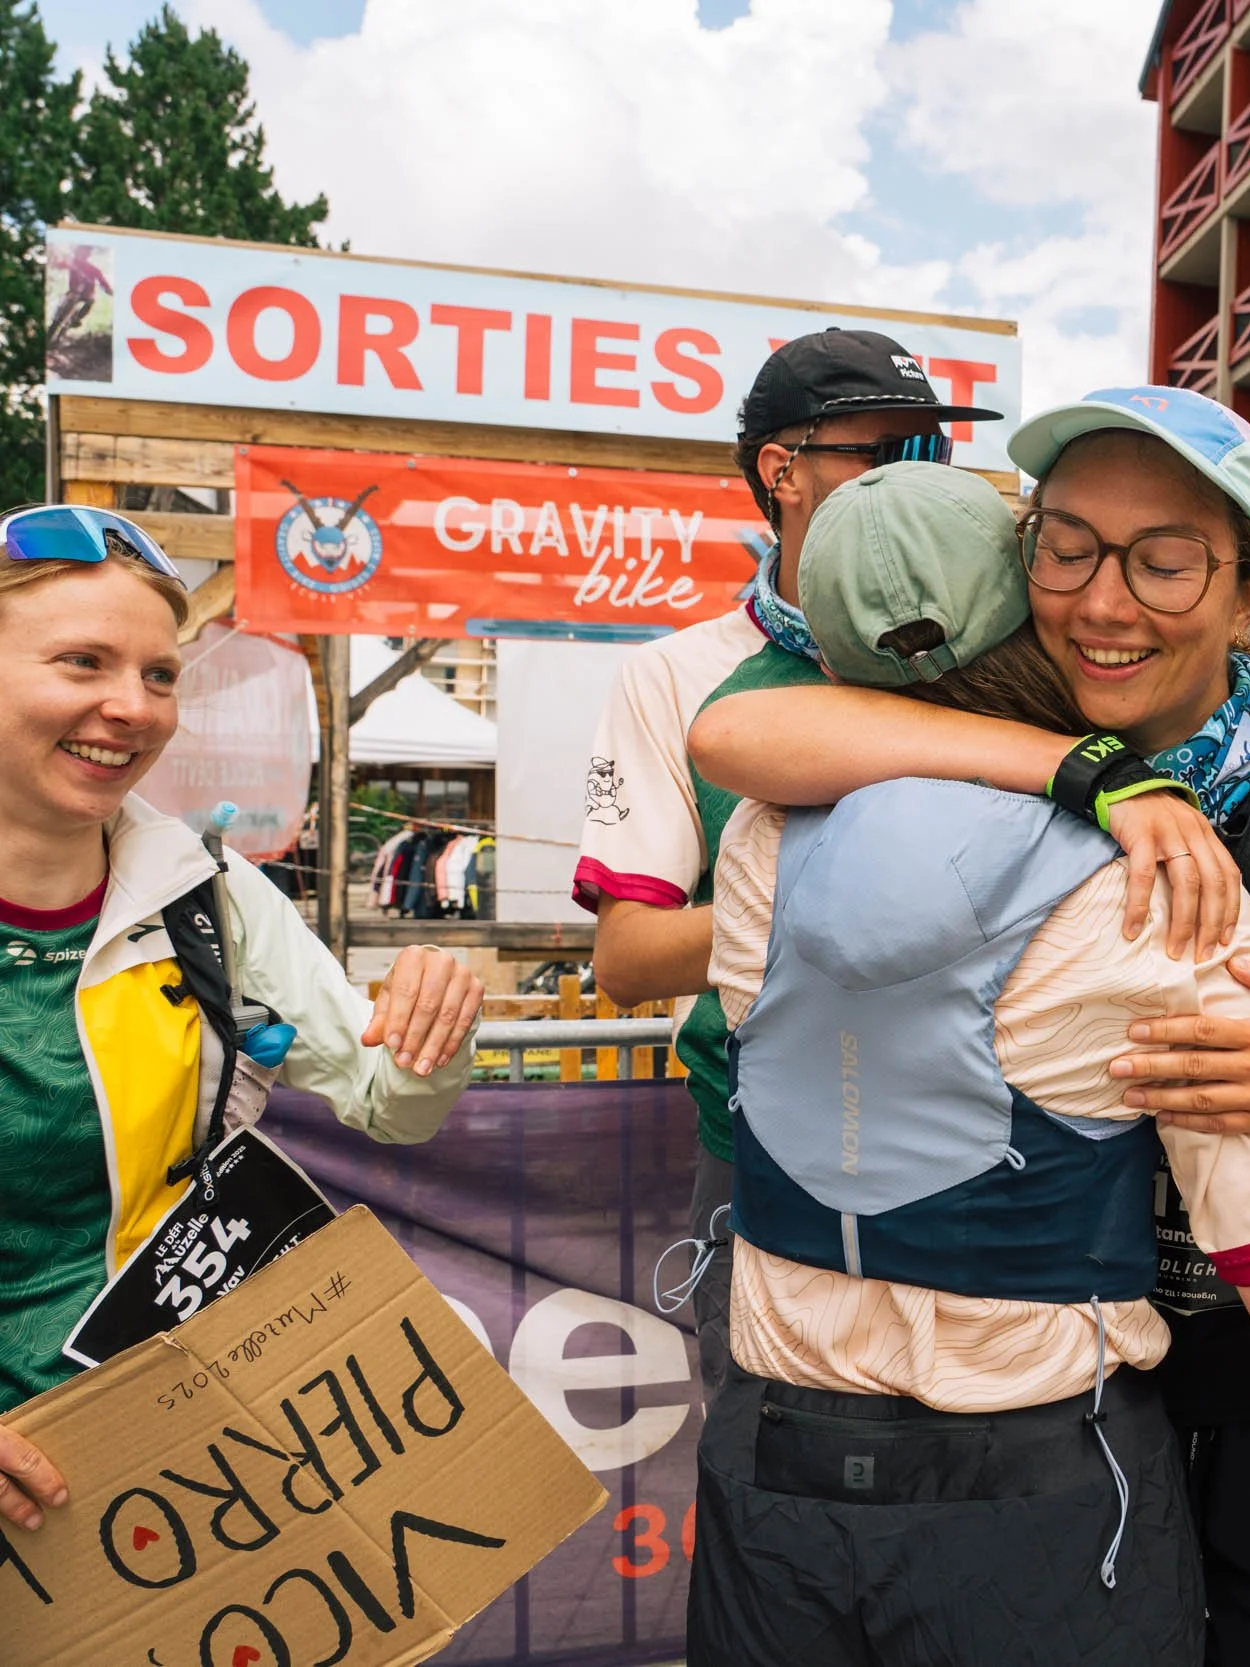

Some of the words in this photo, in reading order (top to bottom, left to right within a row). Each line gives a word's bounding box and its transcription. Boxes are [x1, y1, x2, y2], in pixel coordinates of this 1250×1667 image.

[127, 275, 725, 414] SORTIES
[434, 496, 703, 563] GRAVITY
[573, 545, 703, 610] bike
[838, 1030, 862, 1176] SALOMON
[154, 1215, 251, 1323] 354
[155, 1243, 168, 1258] LE
[164, 1221, 185, 1245] DÉFI
[155, 1213, 209, 1286] Muzelle
[99, 1315, 466, 1588] PIERRO
